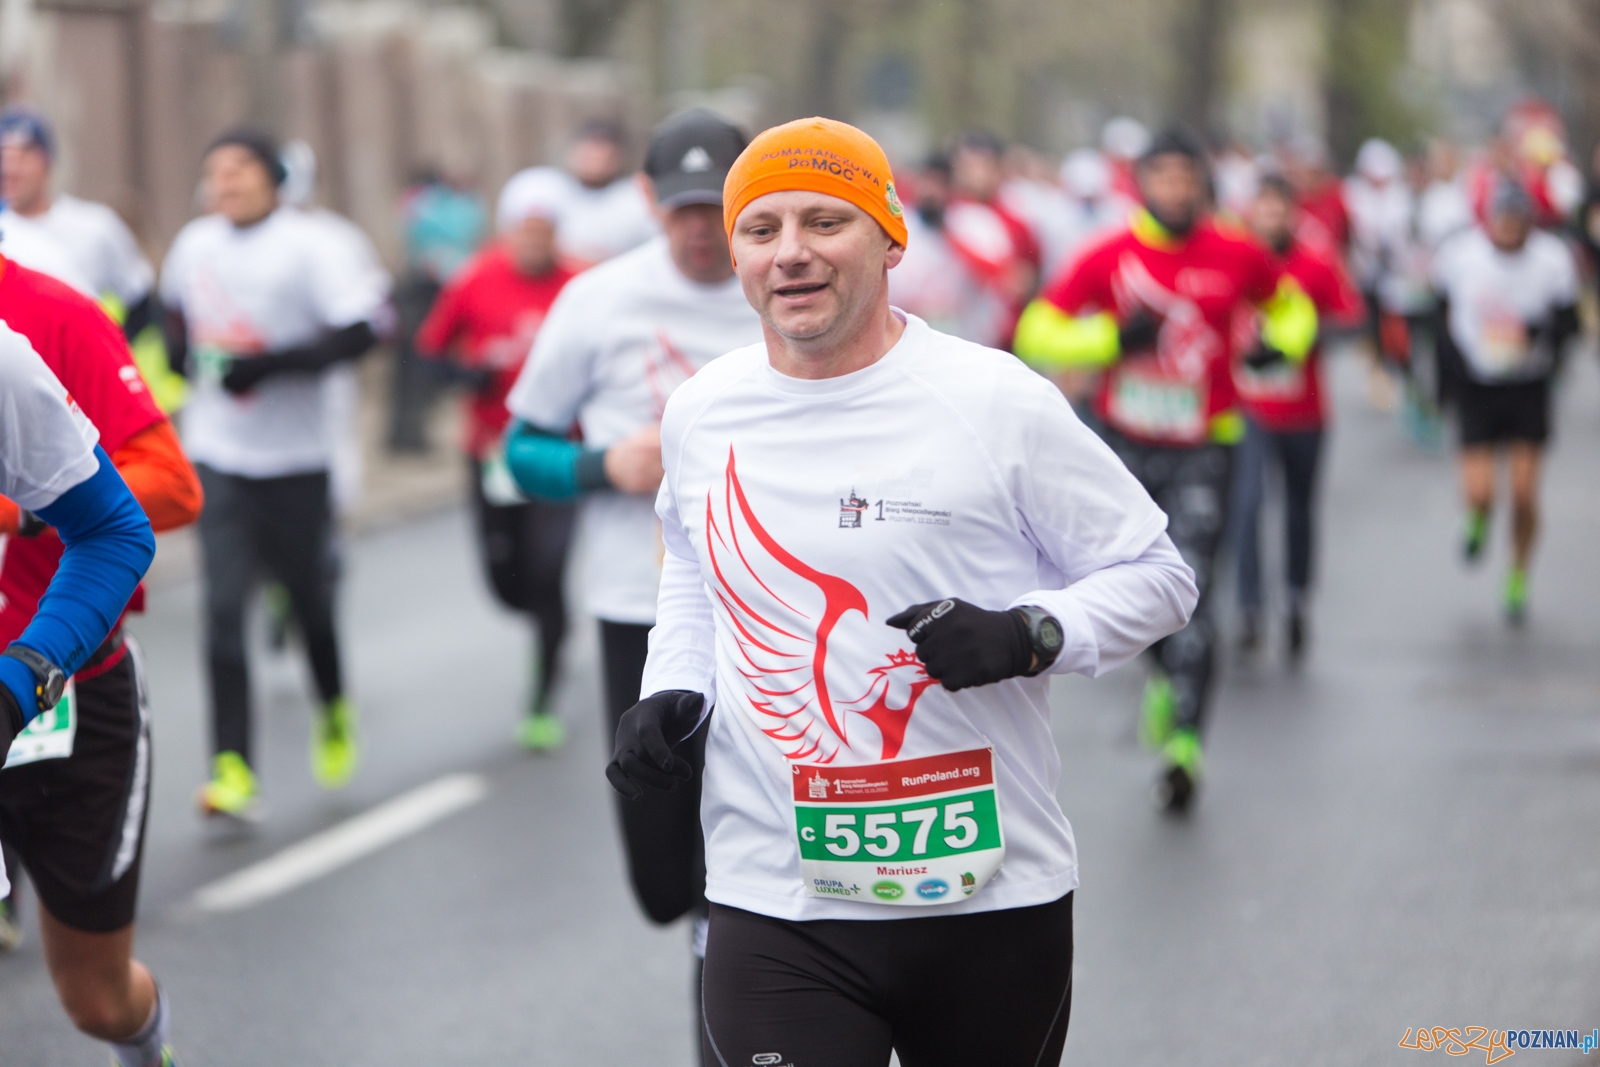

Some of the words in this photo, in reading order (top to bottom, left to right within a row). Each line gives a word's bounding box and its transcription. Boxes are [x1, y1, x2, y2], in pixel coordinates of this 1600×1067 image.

[874, 499, 886, 521] 1
[901, 766, 981, 787] RunPoland.org
[832, 779, 844, 794] 1
[824, 800, 980, 858] 5575
[876, 866, 928, 876] Mariusz
[813, 879, 844, 889] GRUPA
[815, 886, 851, 897] LUXMED
